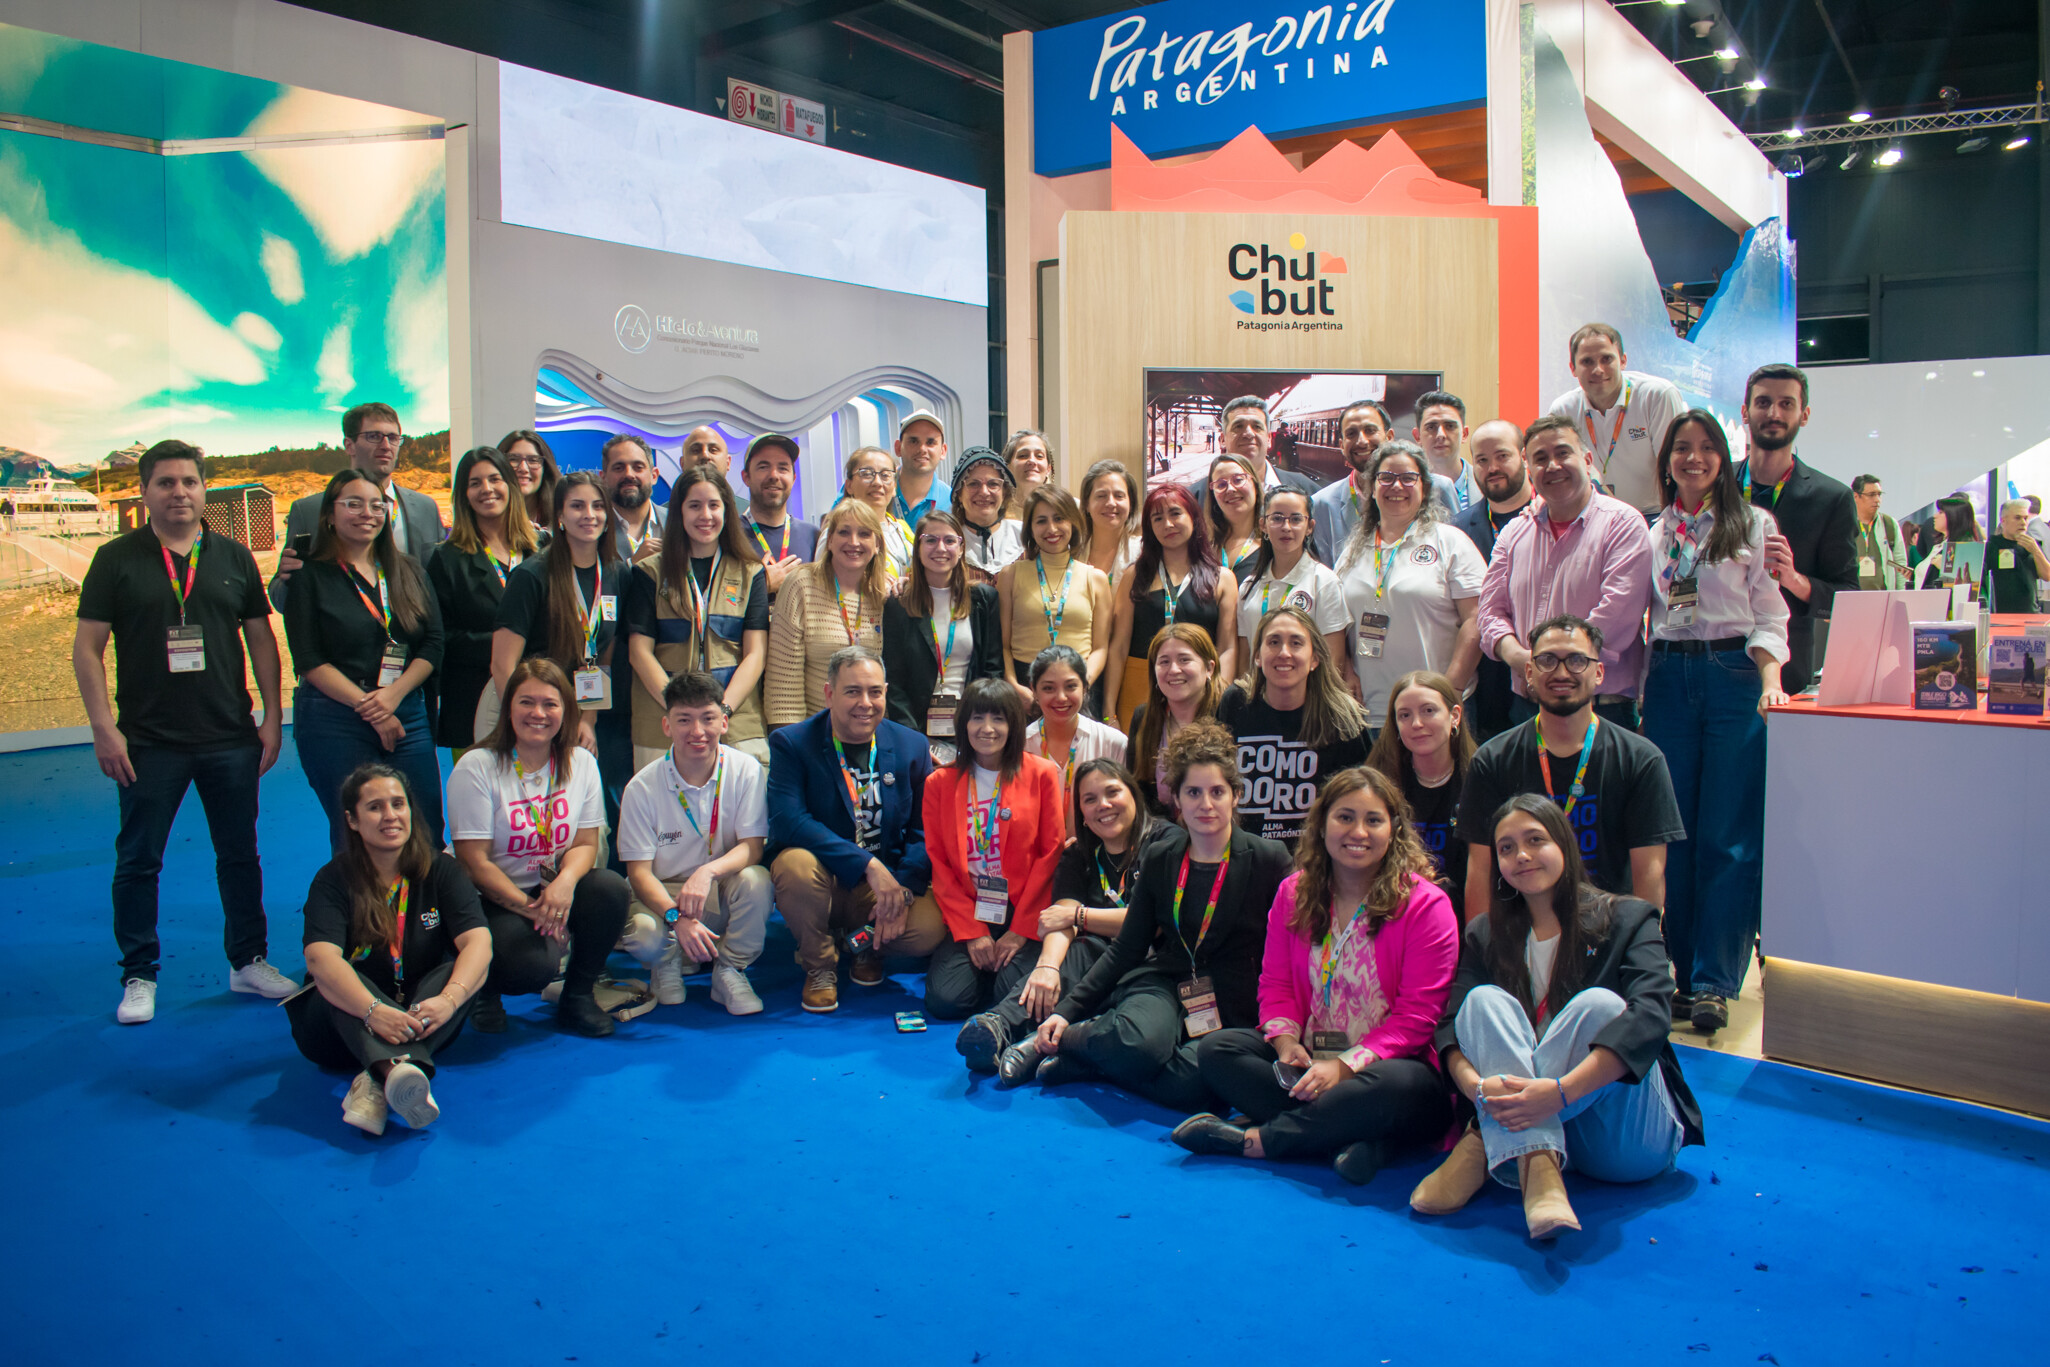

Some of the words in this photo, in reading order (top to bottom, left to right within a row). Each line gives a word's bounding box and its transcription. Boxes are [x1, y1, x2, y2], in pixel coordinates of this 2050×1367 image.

[1089, 0, 1396, 106] Patagonia
[1111, 46, 1388, 116] ARGENTINA
[795, 106, 824, 125] MATAFUEGOS
[1228, 243, 1315, 281] Chu
[1260, 278, 1335, 316] but
[1237, 320, 1290, 332] Patagonia
[1291, 320, 1343, 332] Argentina
[126, 506, 138, 529] 1
[2034, 640, 2046, 648] EN
[1237, 744, 1318, 779] COMO
[1261, 828, 1307, 839] PATAGÓNI
[1262, 823, 1284, 832] ALMA
